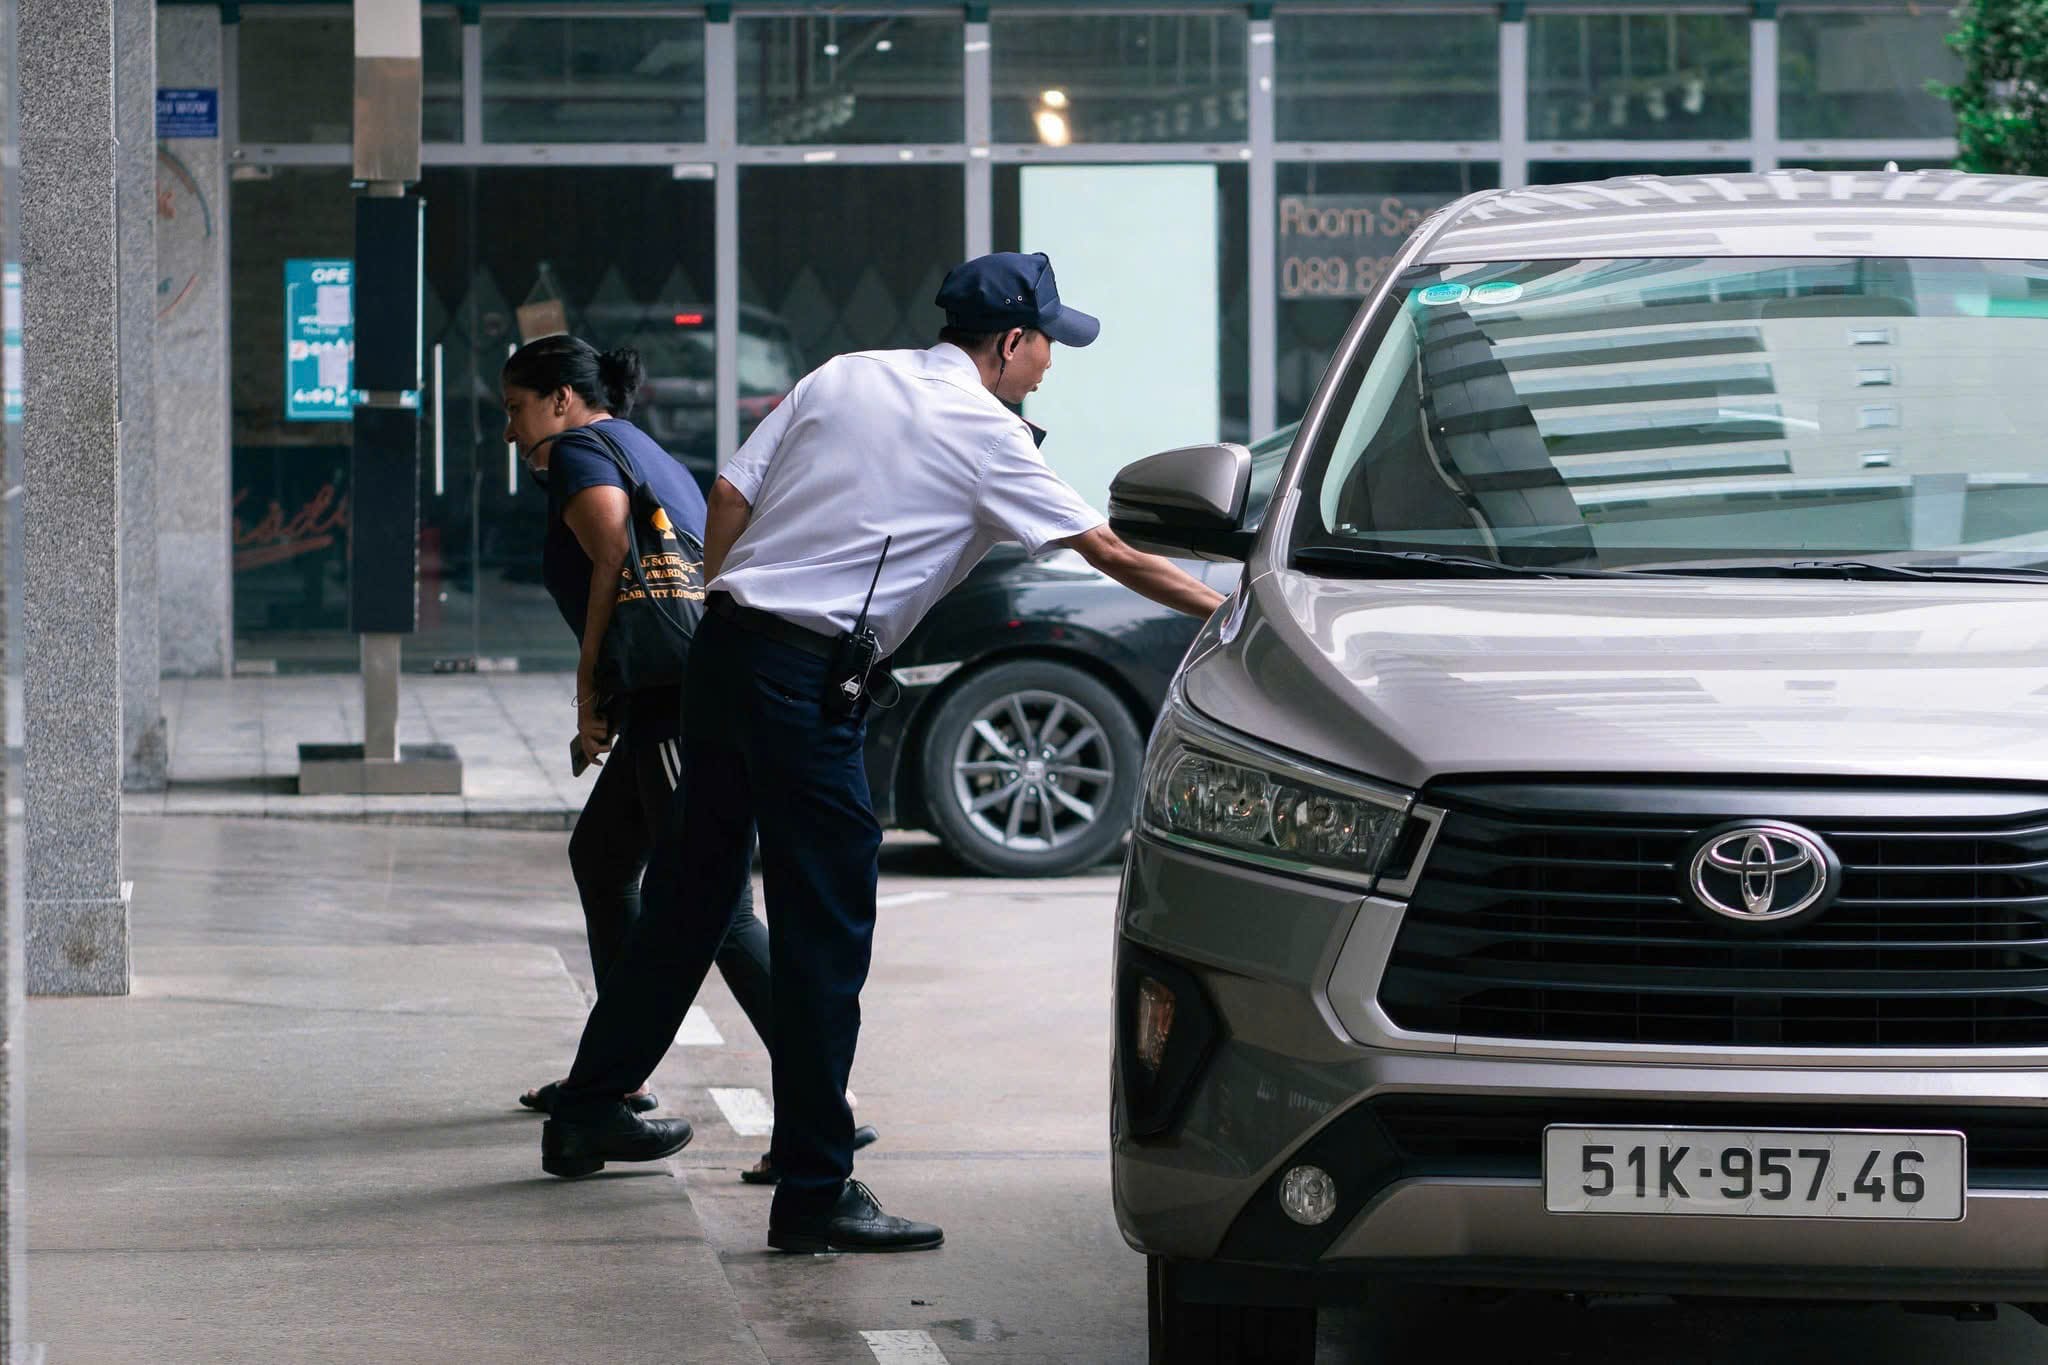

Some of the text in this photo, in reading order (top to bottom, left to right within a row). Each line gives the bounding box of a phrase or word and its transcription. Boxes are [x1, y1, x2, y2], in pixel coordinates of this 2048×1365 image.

[1280, 198, 1438, 237] Room Se
[311, 268, 351, 284] OPE
[1282, 256, 1349, 297] 089
[1581, 1145, 1925, 1203] 51K-957.46
